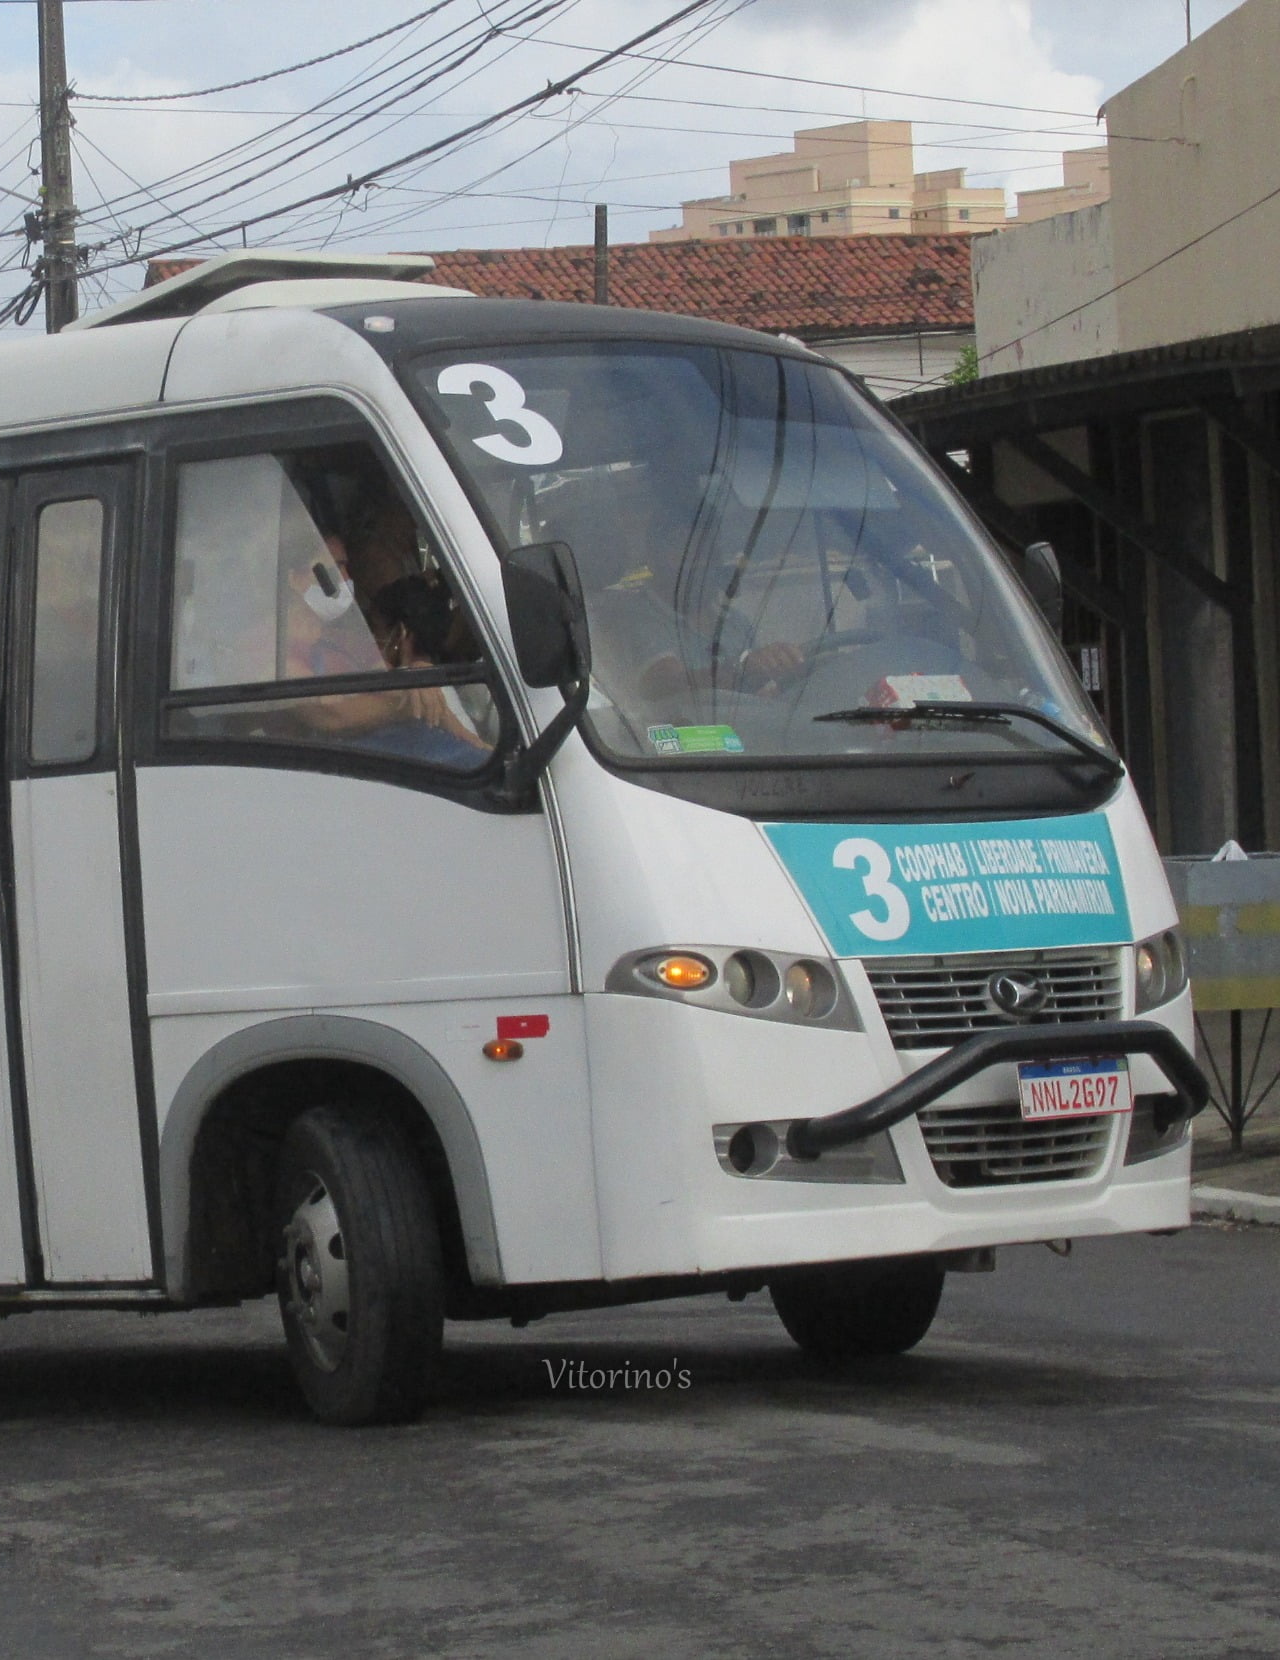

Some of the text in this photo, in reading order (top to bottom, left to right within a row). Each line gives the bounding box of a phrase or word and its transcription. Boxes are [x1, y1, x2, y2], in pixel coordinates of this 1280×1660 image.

[437, 363, 563, 465] 3
[895, 842, 968, 882] COOPHAB
[969, 839, 1042, 875] LIBERDADE
[1040, 839, 1110, 875] PRIMAVERA
[832, 837, 911, 942] 3
[921, 881, 989, 922] CENTRO
[993, 879, 1038, 915] NOVA
[1031, 879, 1115, 914] PARNAMIRIM
[1031, 1075, 1119, 1113] NNL2G97
